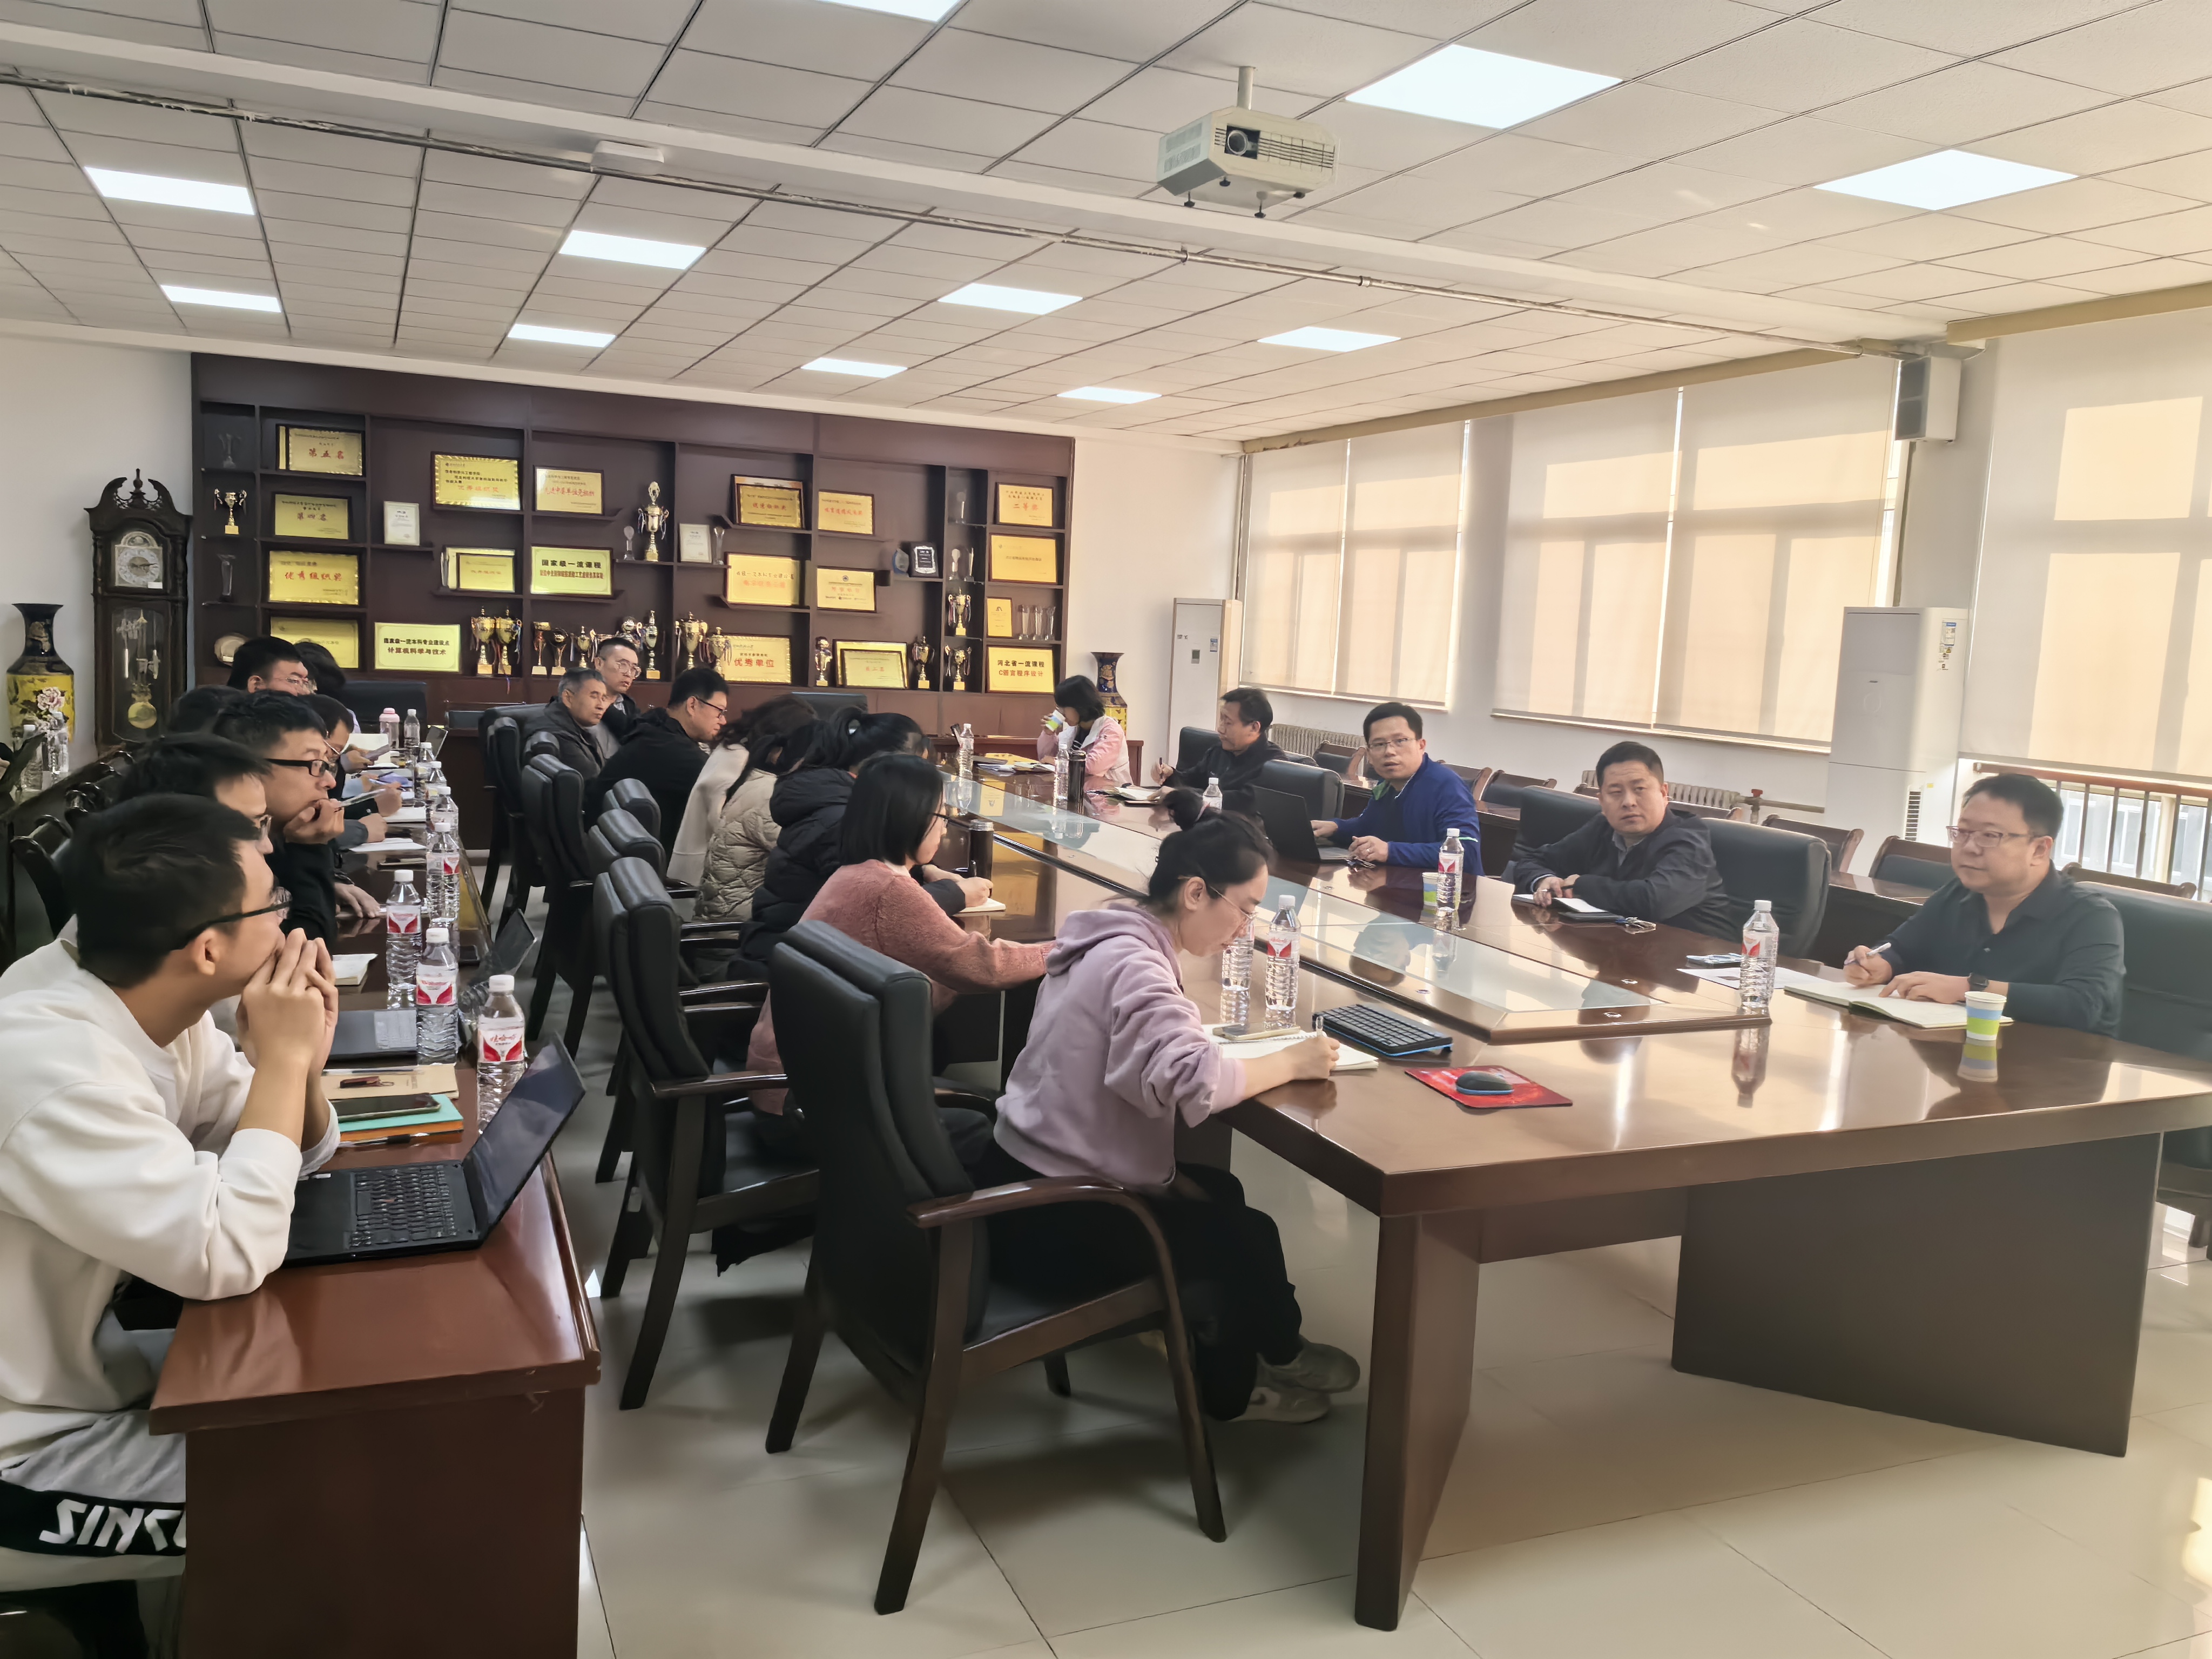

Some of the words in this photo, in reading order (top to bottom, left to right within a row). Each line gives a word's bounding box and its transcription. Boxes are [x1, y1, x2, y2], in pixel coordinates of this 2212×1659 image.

[308, 448, 344, 459] 第五名
[1013, 503, 1038, 511] 二等奖
[542, 559, 601, 569] 国家级一流课程
[285, 571, 342, 582] 优秀组织奖
[384, 637, 450, 646] 国家级一流本科专业建设点
[387, 647, 447, 656] 计算机科学与技术
[734, 658, 774, 667] 优秀单位
